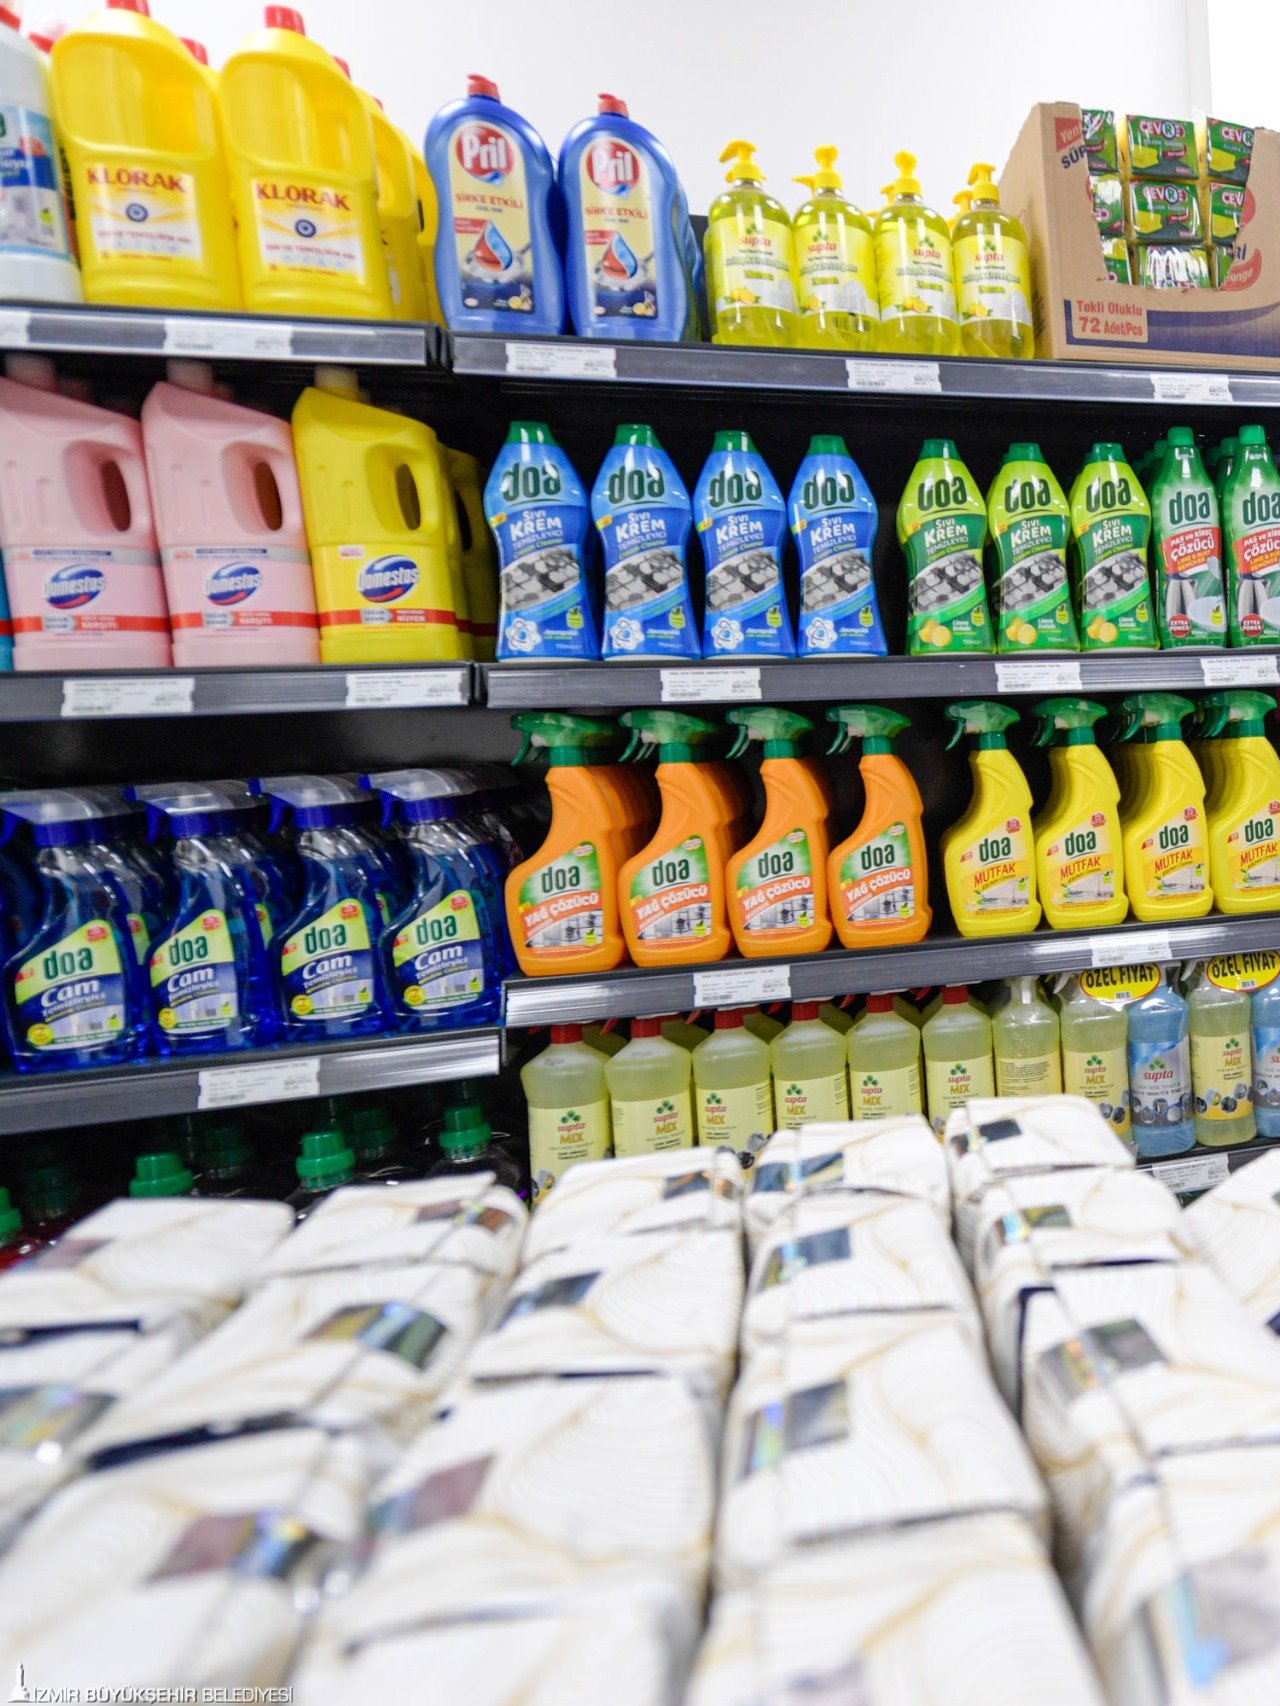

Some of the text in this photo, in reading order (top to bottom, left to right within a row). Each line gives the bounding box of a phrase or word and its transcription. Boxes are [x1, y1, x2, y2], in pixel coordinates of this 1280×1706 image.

[462, 132, 507, 169] Pril
[592, 149, 633, 183] Pril
[87, 168, 186, 193] KLORAK
[256, 183, 350, 211] KLORAK
[1077, 299, 1142, 317] Tekli Oluklu
[1079, 316, 1101, 333] 72
[501, 462, 561, 501] doa
[608, 465, 665, 504] doa
[709, 470, 762, 508] doa
[1169, 491, 1211, 525] doa
[510, 517, 562, 541] KREM
[615, 519, 666, 543] KREM
[715, 521, 763, 545] KREM
[810, 523, 856, 546] KREM
[924, 525, 968, 549] KREM
[1010, 525, 1052, 549] KREM
[1092, 525, 1132, 549] KREM
[1170, 537, 1184, 547] PAS
[1185, 532, 1194, 541] ve
[1243, 537, 1258, 547] PAS
[1258, 532, 1267, 541] ve
[1171, 538, 1215, 562] ÇÖZÜCÜ
[44, 572, 105, 598] Domestos
[204, 571, 261, 597] Domestos
[357, 565, 420, 593] Domestos
[1169, 619, 1189, 627] EXTRA
[1243, 619, 1260, 627] EXTRA
[1065, 830, 1097, 856] doa
[1159, 824, 1189, 849] doa
[1244, 818, 1274, 843] doa
[861, 844, 895, 870] doa
[979, 836, 1011, 862] doa
[1154, 849, 1194, 874] MUTFAK
[1240, 843, 1277, 867] MUTFAK
[652, 859, 690, 887] doa
[758, 851, 794, 878] doa
[974, 863, 1016, 887] MUTFAK
[1060, 856, 1101, 880] MUTFAK
[542, 865, 580, 893] doa
[743, 891, 765, 910] YAĞ
[847, 883, 868, 901] YAĞ
[525, 905, 549, 927] YAĞ
[636, 899, 660, 918] YAĞ
[304, 924, 347, 954] doa
[415, 915, 458, 946] doa
[169, 935, 208, 966] doa
[414, 945, 463, 971] Cam
[43, 947, 93, 980] doa
[302, 954, 352, 980] Cam
[1212, 957, 1241, 979] ÖZEL
[167, 967, 214, 993] Cam
[1086, 966, 1117, 988] ÖZEL
[40, 979, 99, 1008] Cam
[1142, 1068, 1173, 1082] supta
